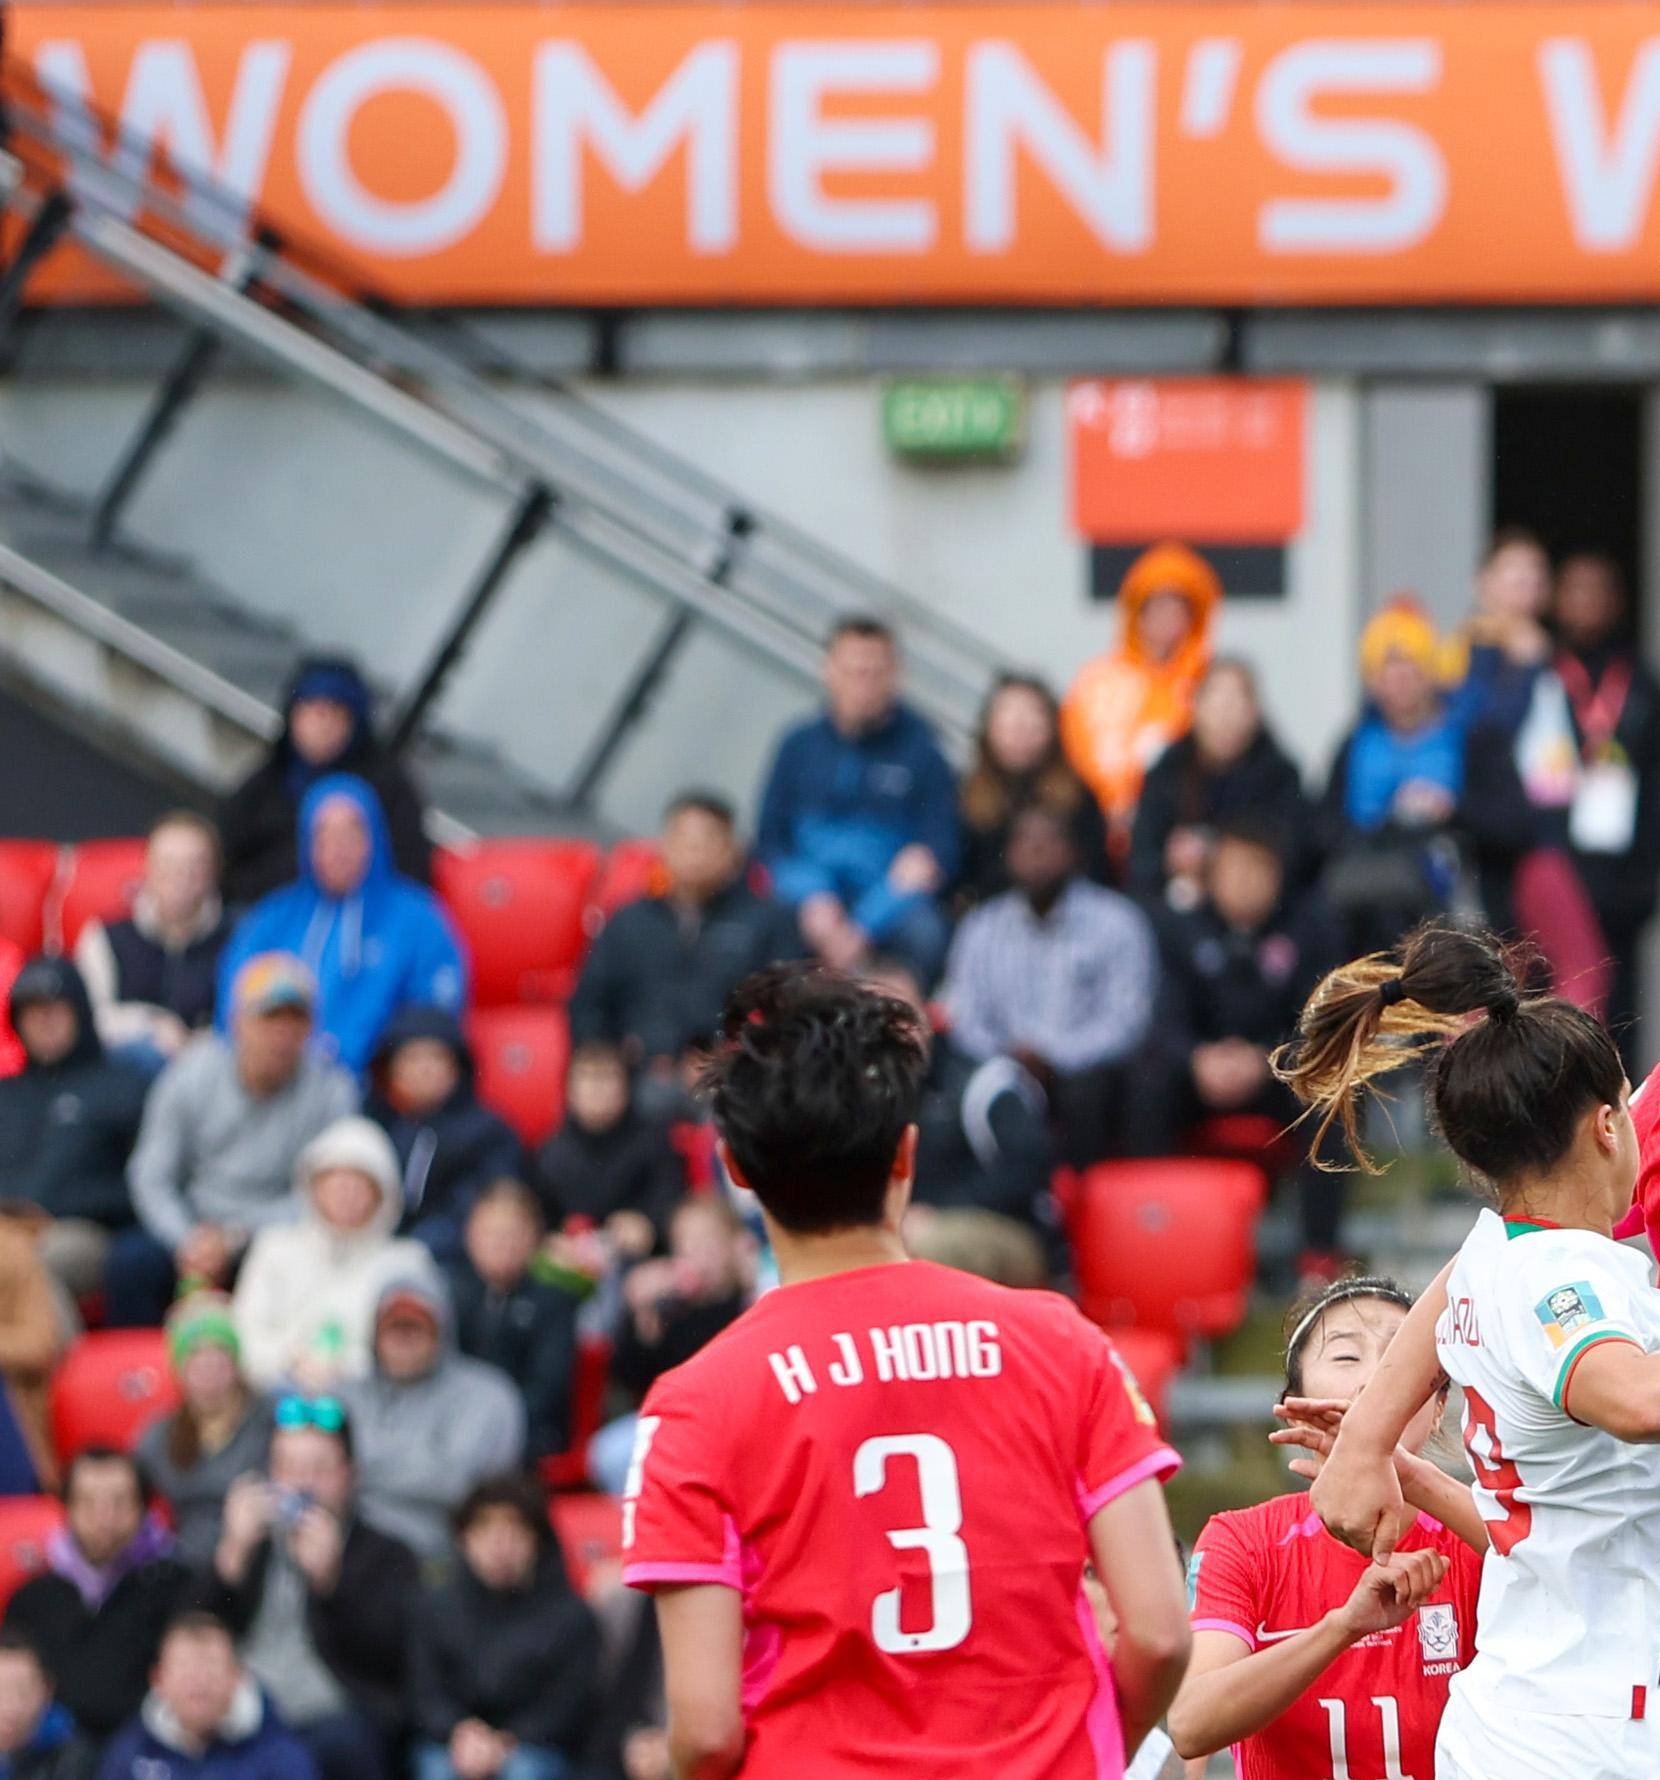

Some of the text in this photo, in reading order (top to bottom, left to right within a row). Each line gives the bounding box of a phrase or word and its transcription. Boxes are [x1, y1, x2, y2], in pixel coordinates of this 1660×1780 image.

[34, 37, 1448, 255] WOMEN'S
[768, 1321, 1002, 1404] H J HONG
[853, 1433, 973, 1654] 3
[1422, 1661, 1461, 1677] KOREA
[1318, 1695, 1416, 1780] 11
